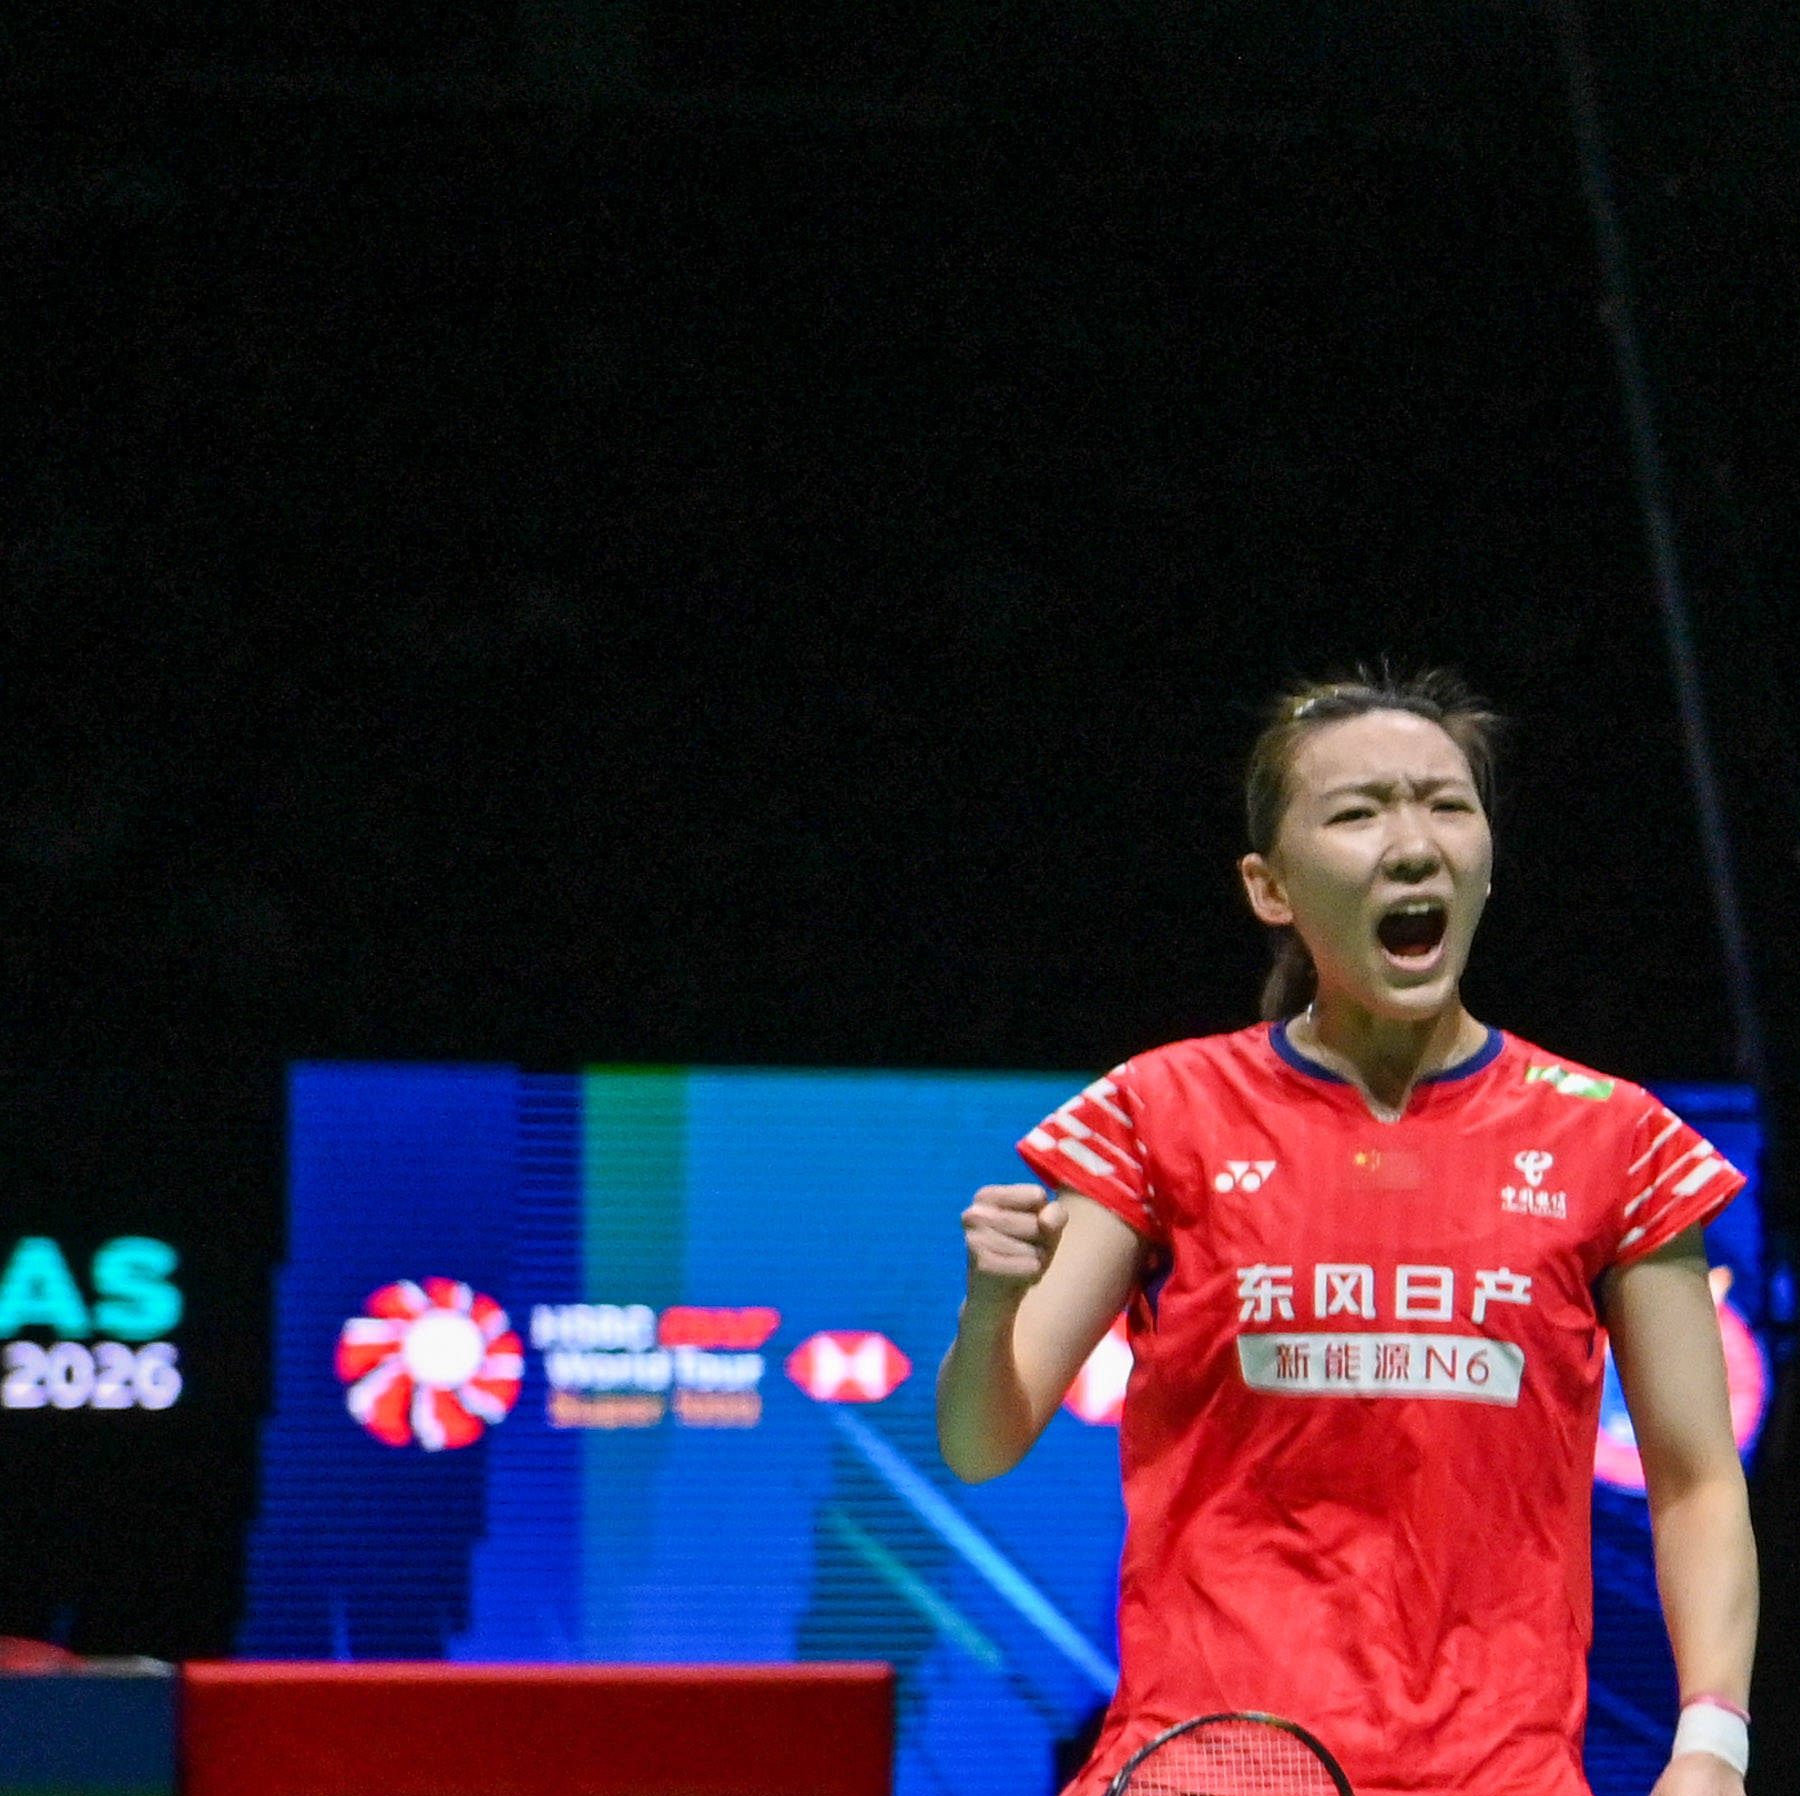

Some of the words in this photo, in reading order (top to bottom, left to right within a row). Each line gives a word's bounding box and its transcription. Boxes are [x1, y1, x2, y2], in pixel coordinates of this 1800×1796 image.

[0, 1235, 183, 1340] AS
[1236, 1263, 1533, 1325] 东风日产
[2, 1341, 183, 1410] 2026
[1275, 1342, 1491, 1386] 新能源N6
